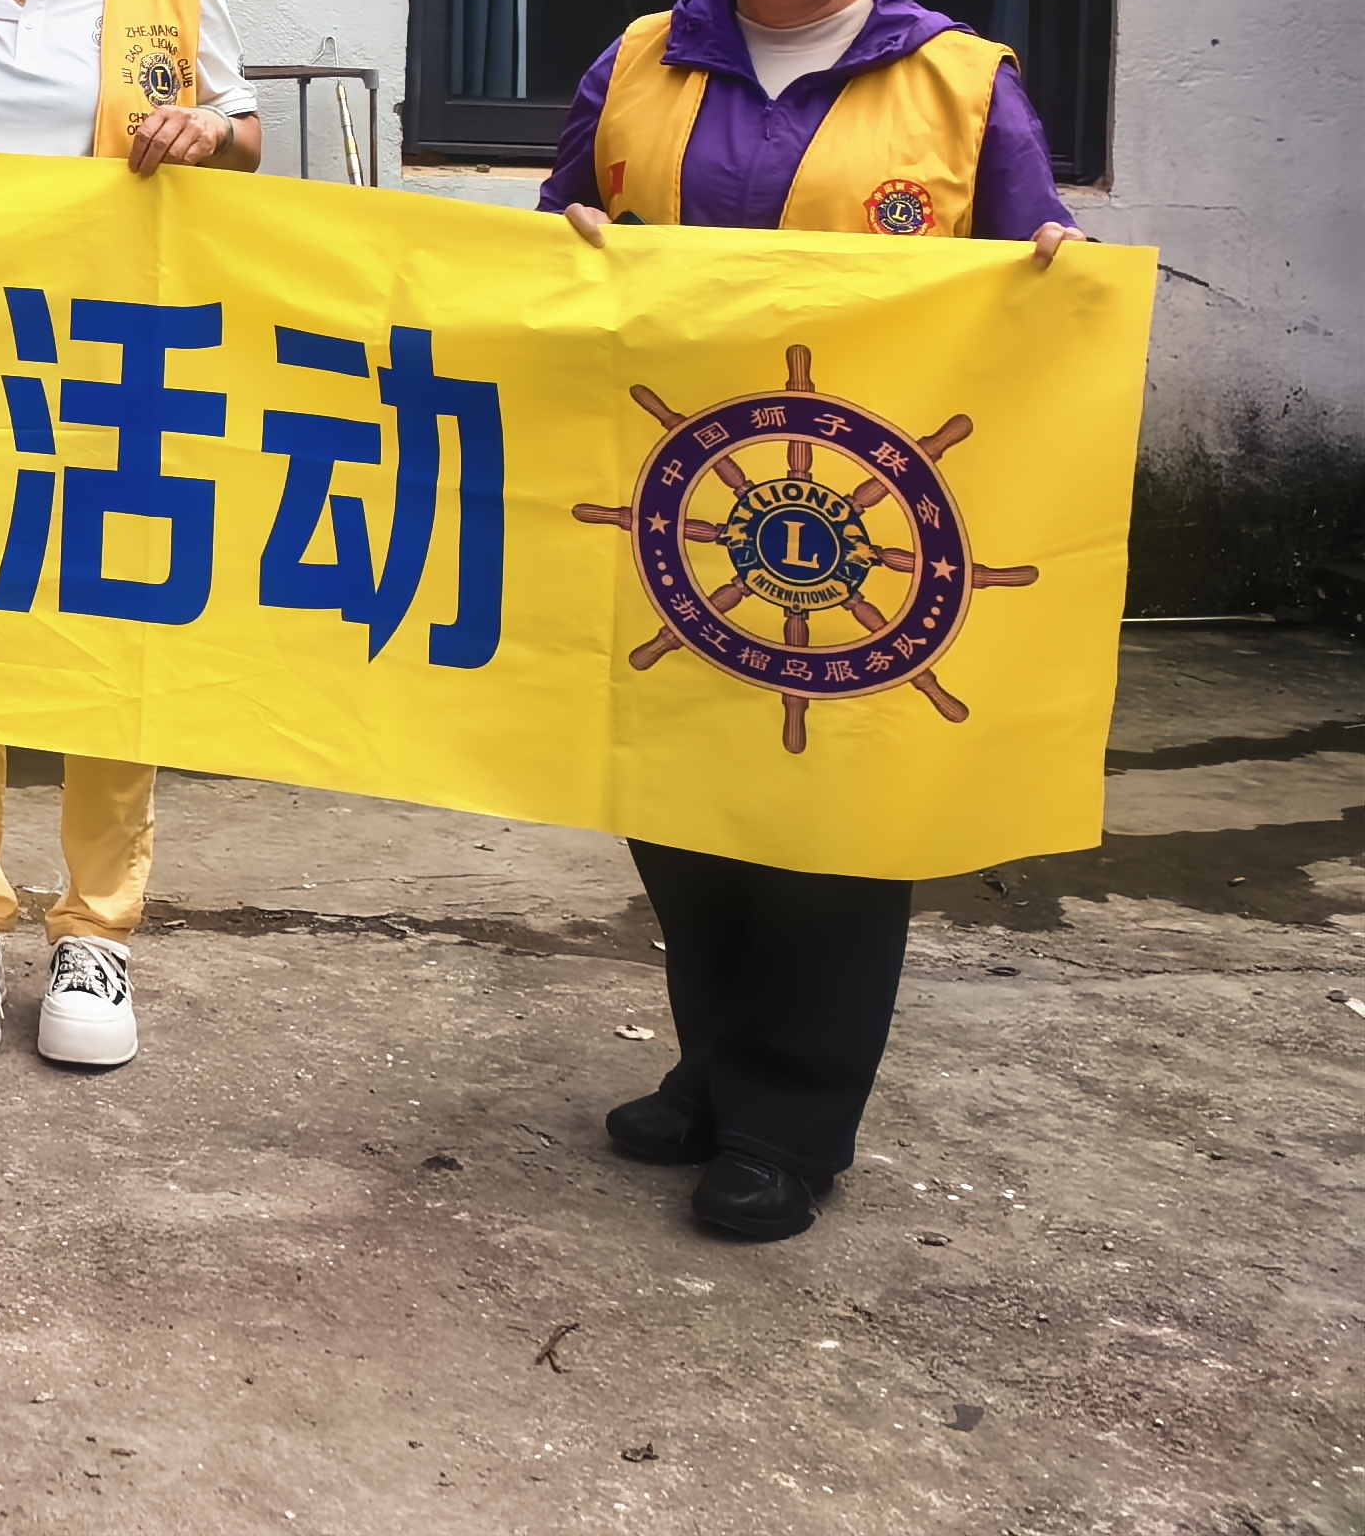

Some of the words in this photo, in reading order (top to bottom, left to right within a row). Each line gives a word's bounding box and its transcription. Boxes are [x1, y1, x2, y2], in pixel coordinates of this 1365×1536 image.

[125, 25, 178, 37] ZHEJIANG
[151, 38, 178, 56] LIONS
[178, 58, 193, 88] CLUB
[660, 405, 941, 529] 中国狮子联会
[757, 483, 846, 521] LIONS
[782, 520, 820, 569] L
[751, 574, 843, 605] INTERNATIONAL
[670, 593, 927, 683] 浙江榴岛服务队
